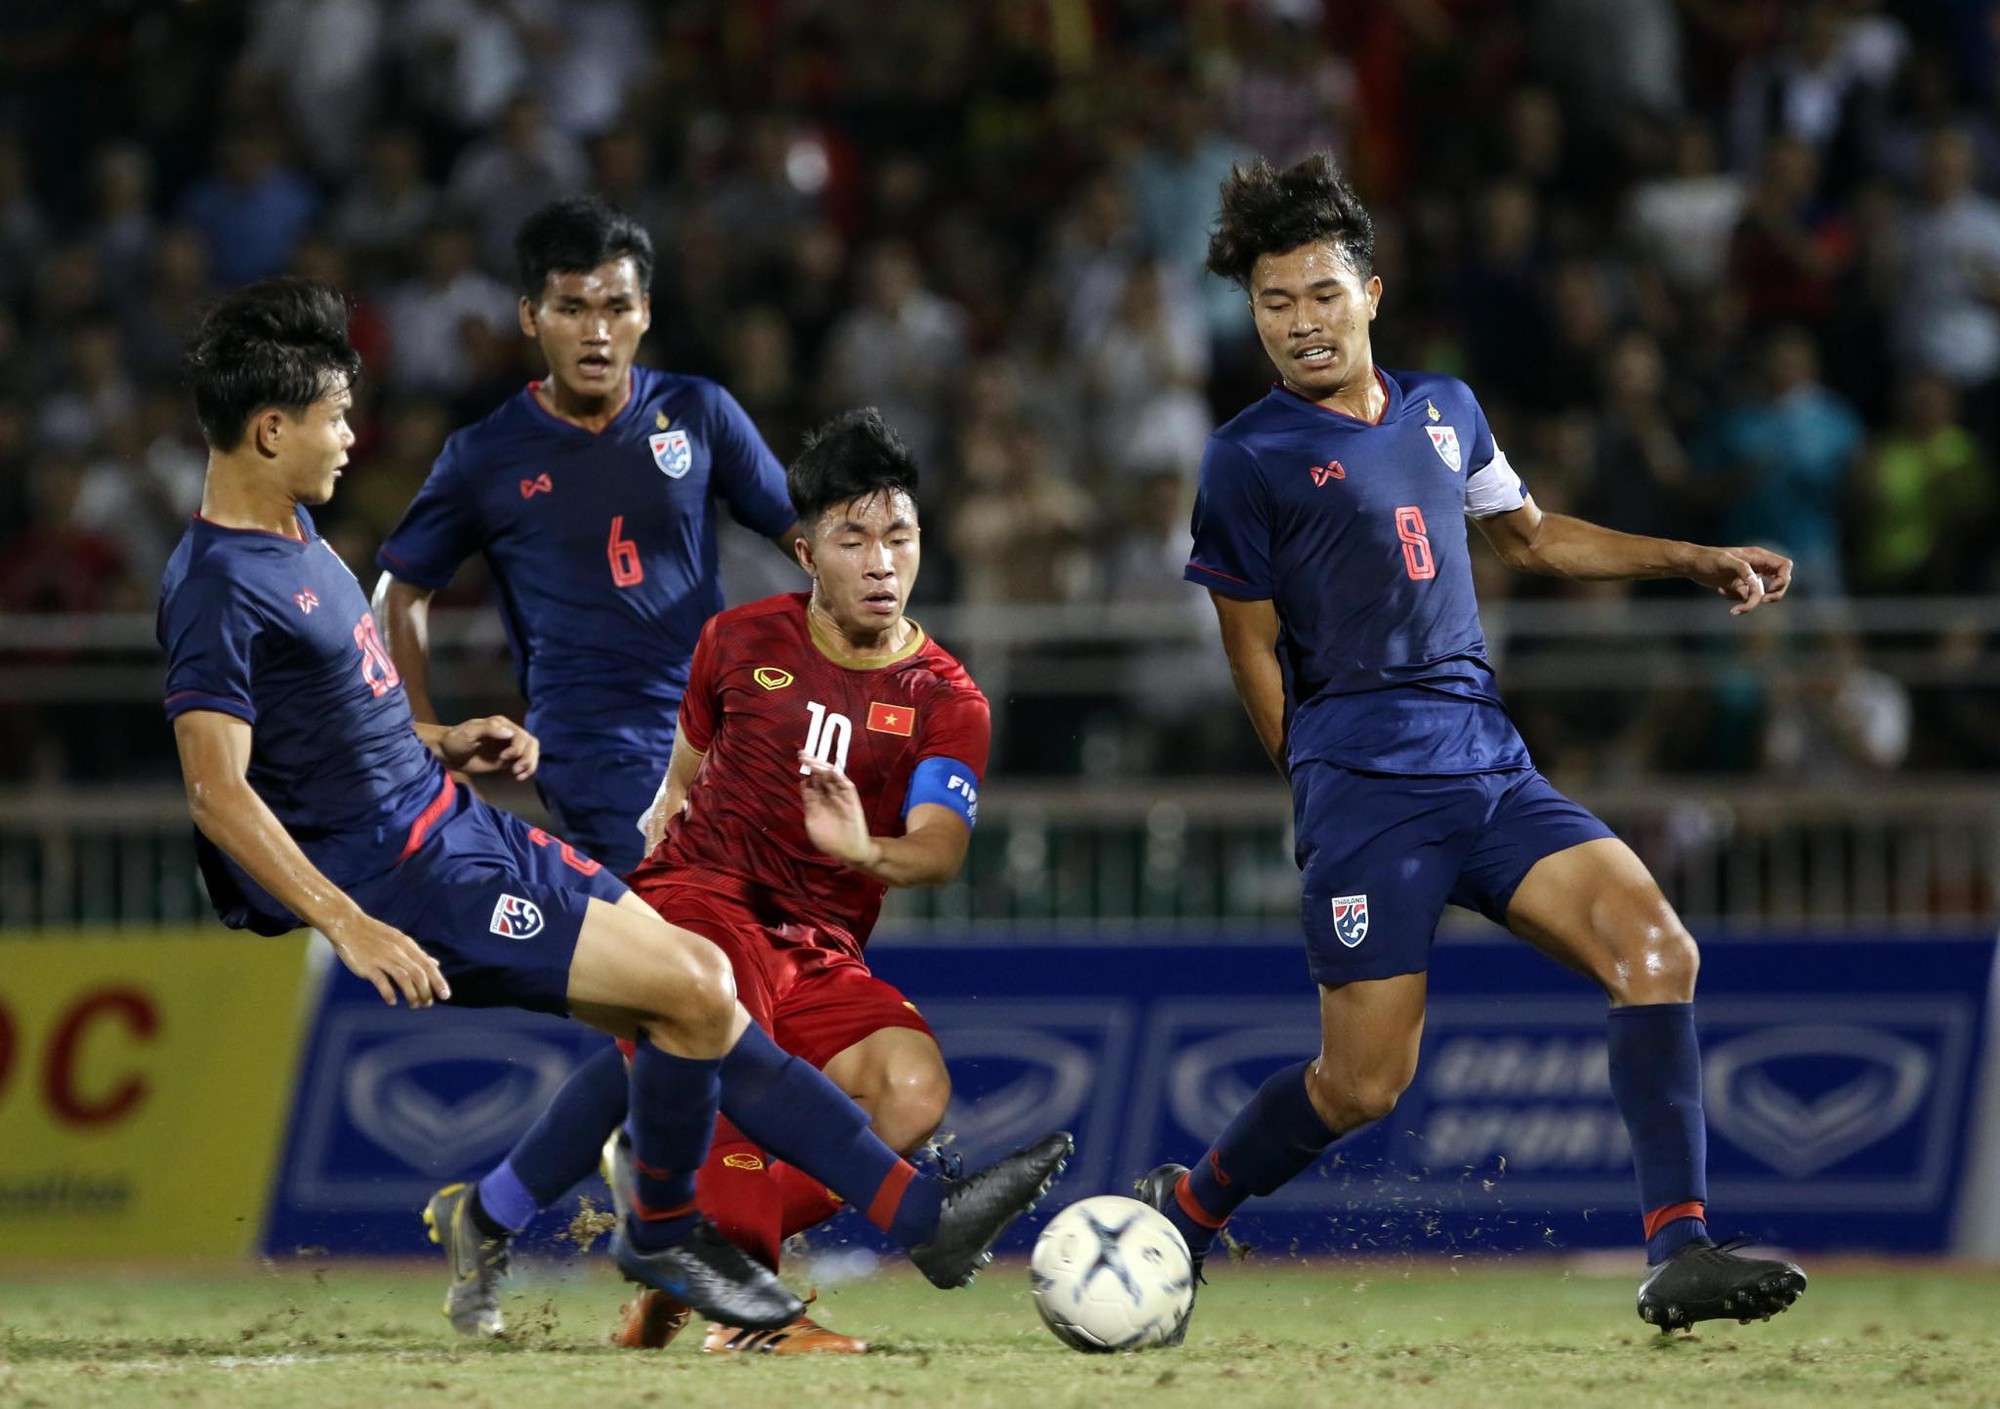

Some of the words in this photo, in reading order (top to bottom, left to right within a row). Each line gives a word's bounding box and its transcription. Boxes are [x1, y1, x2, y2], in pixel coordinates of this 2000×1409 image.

[607, 515, 644, 588] 6
[1394, 505, 1436, 580] 8
[799, 701, 853, 776] 10
[0, 986, 157, 1130] C
